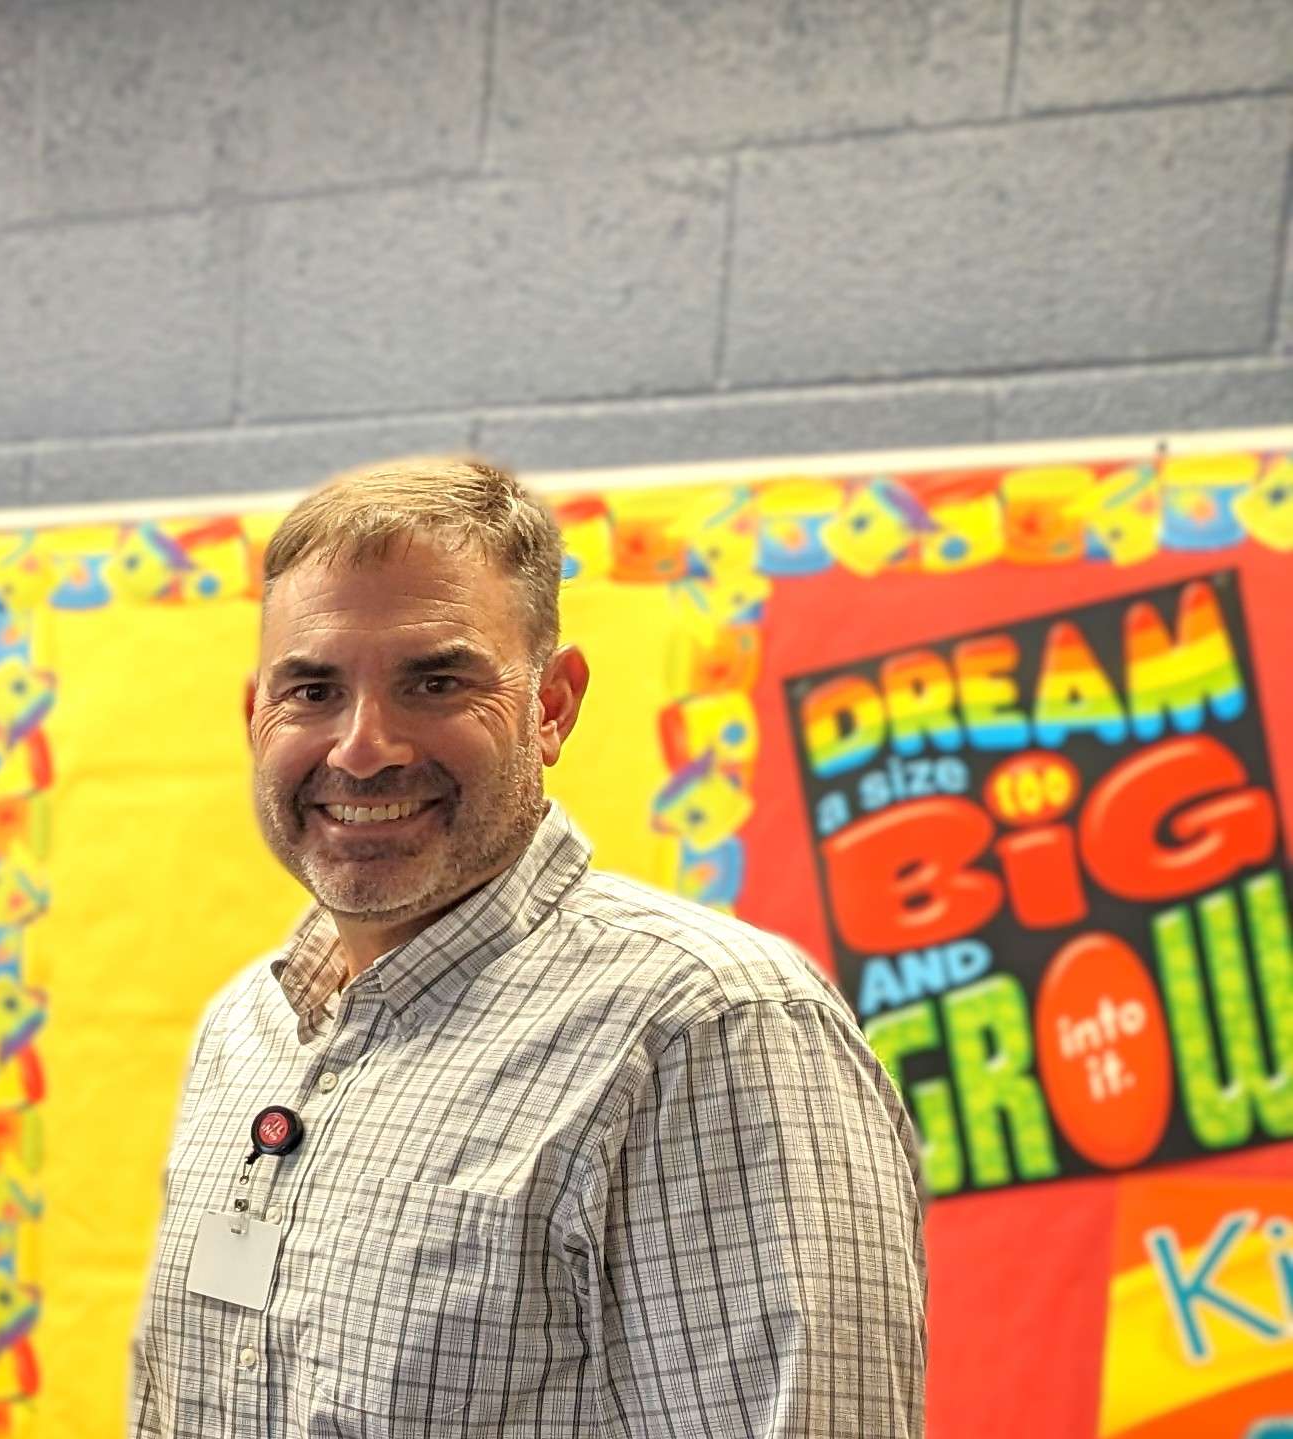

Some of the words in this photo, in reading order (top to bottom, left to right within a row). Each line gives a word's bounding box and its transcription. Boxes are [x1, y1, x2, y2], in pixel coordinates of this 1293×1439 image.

[801, 580, 1247, 778] DREAM
[818, 791, 850, 835] a
[858, 756, 970, 810] size
[993, 768, 1074, 822] too
[860, 940, 991, 1014] AND
[1058, 996, 1147, 1059] into
